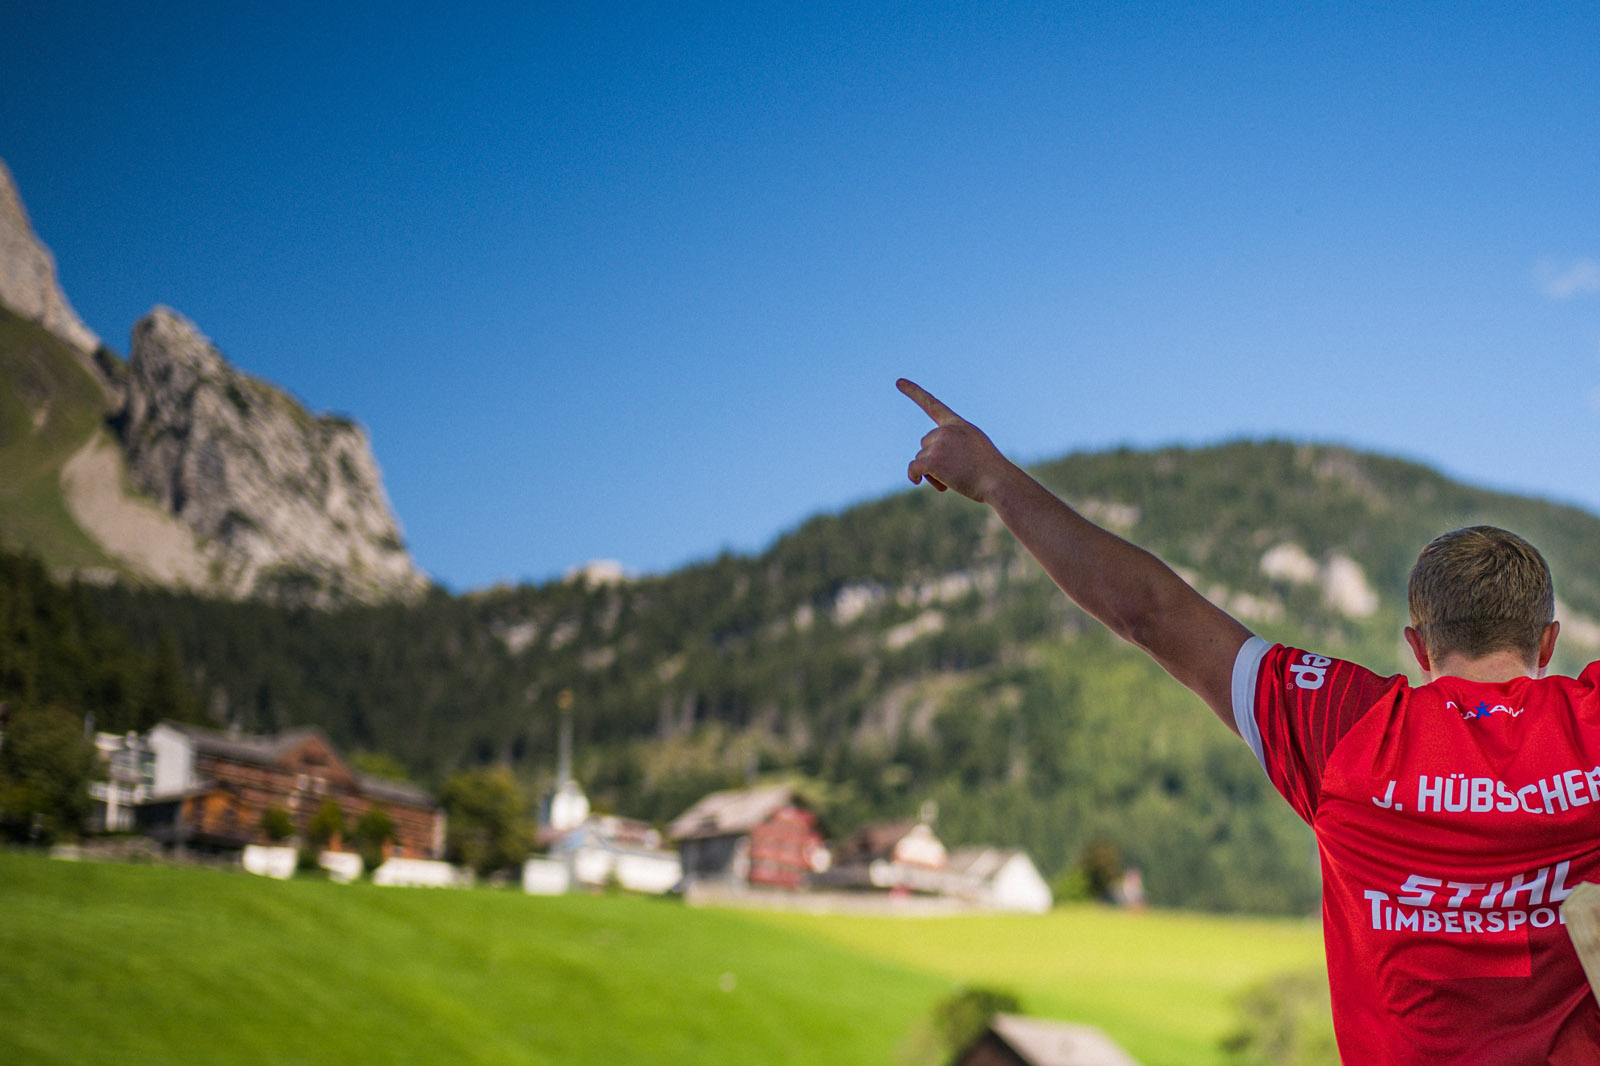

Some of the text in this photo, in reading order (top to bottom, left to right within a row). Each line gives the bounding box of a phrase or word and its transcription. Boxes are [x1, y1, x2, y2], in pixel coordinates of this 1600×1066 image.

[1372, 780, 1403, 811] J.
[1397, 860, 1575, 909] STIHL
[1363, 889, 1567, 933] TIMBERSPO
